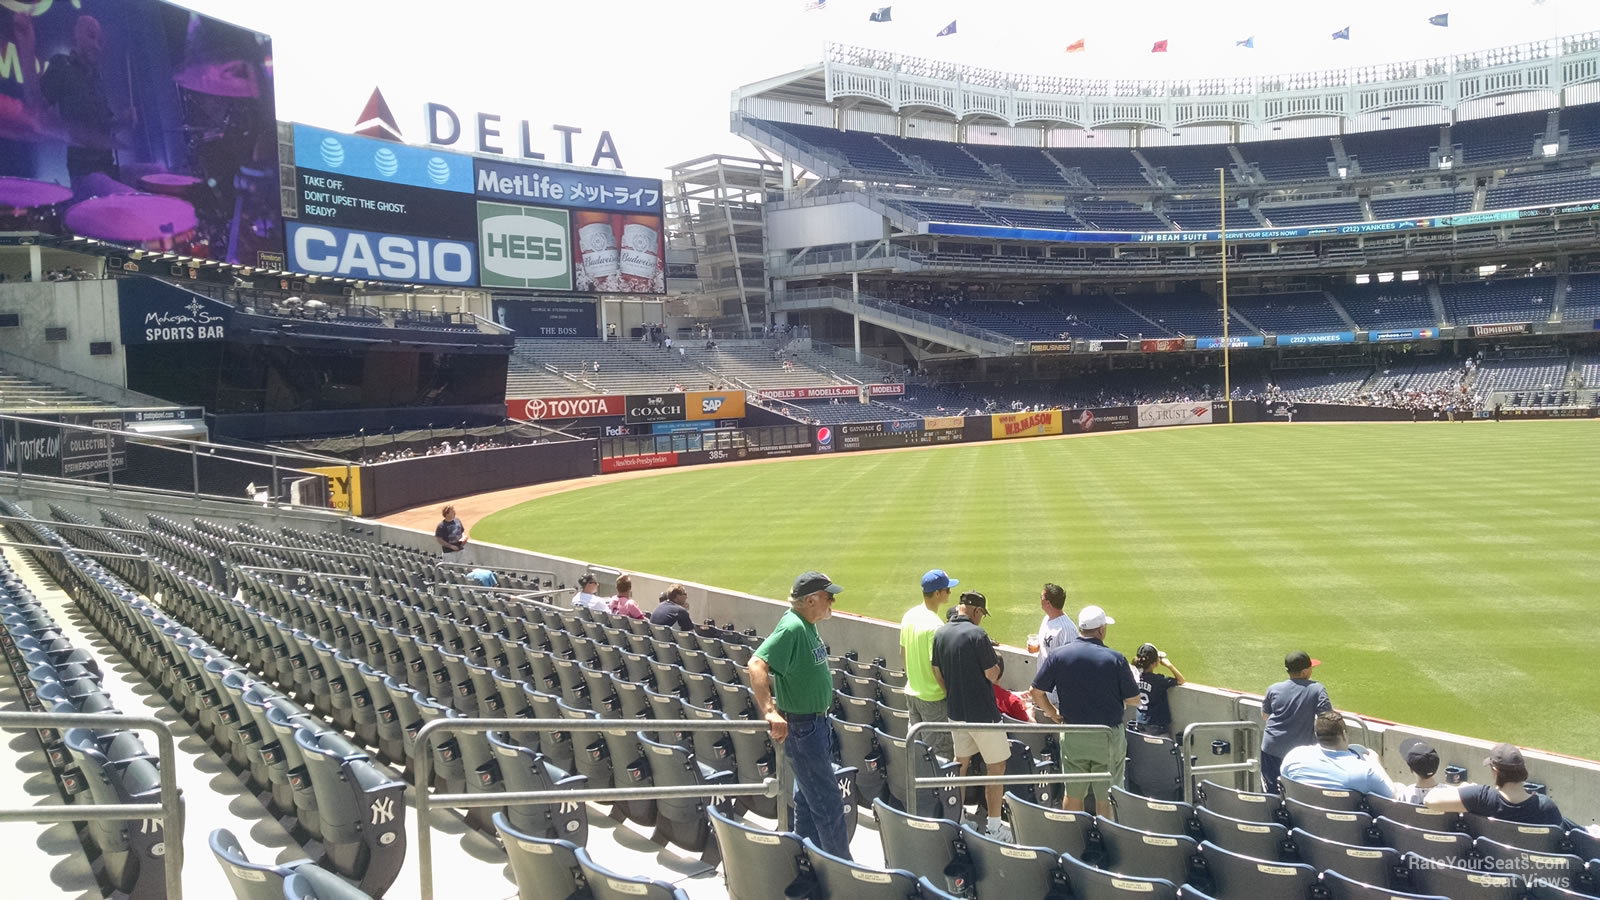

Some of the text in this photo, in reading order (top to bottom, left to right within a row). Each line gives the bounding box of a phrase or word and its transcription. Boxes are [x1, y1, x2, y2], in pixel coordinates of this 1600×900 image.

[423, 102, 623, 169] DELTA
[303, 175, 345, 191] TAKE OFF.
[477, 169, 564, 201] MetLife
[304, 190, 407, 214] DON'T UPSET THE GHOST.
[569, 183, 659, 208] メットライフ
[305, 205, 337, 217] READY?
[1182, 233, 1208, 241] SUITE
[1245, 231, 1261, 239] YOUR
[1361, 223, 1396, 231] YANKEES
[294, 226, 472, 283] CASIO
[487, 233, 562, 261] HESS
[198, 311, 224, 324] Sun
[145, 326, 224, 341] SPORTS BAR
[540, 327, 577, 335] THE BOSS
[1290, 335, 1341, 344] (212) YANKEES
[807, 388, 857, 397] MODELLS.com
[872, 385, 901, 394] MODELL'S
[548, 398, 608, 417] TOYOTA
[630, 405, 681, 417] COACH
[702, 399, 722, 412] SAP
[1156, 408, 1188, 420] TRUST
[605, 425, 631, 436] FedEx
[6, 433, 60, 465] NITOTIRE.COM
[70, 437, 115, 452] COLLECTIBLS
[64, 457, 124, 473] STEINERSPORTSCOM
[371, 796, 395, 825] NY
